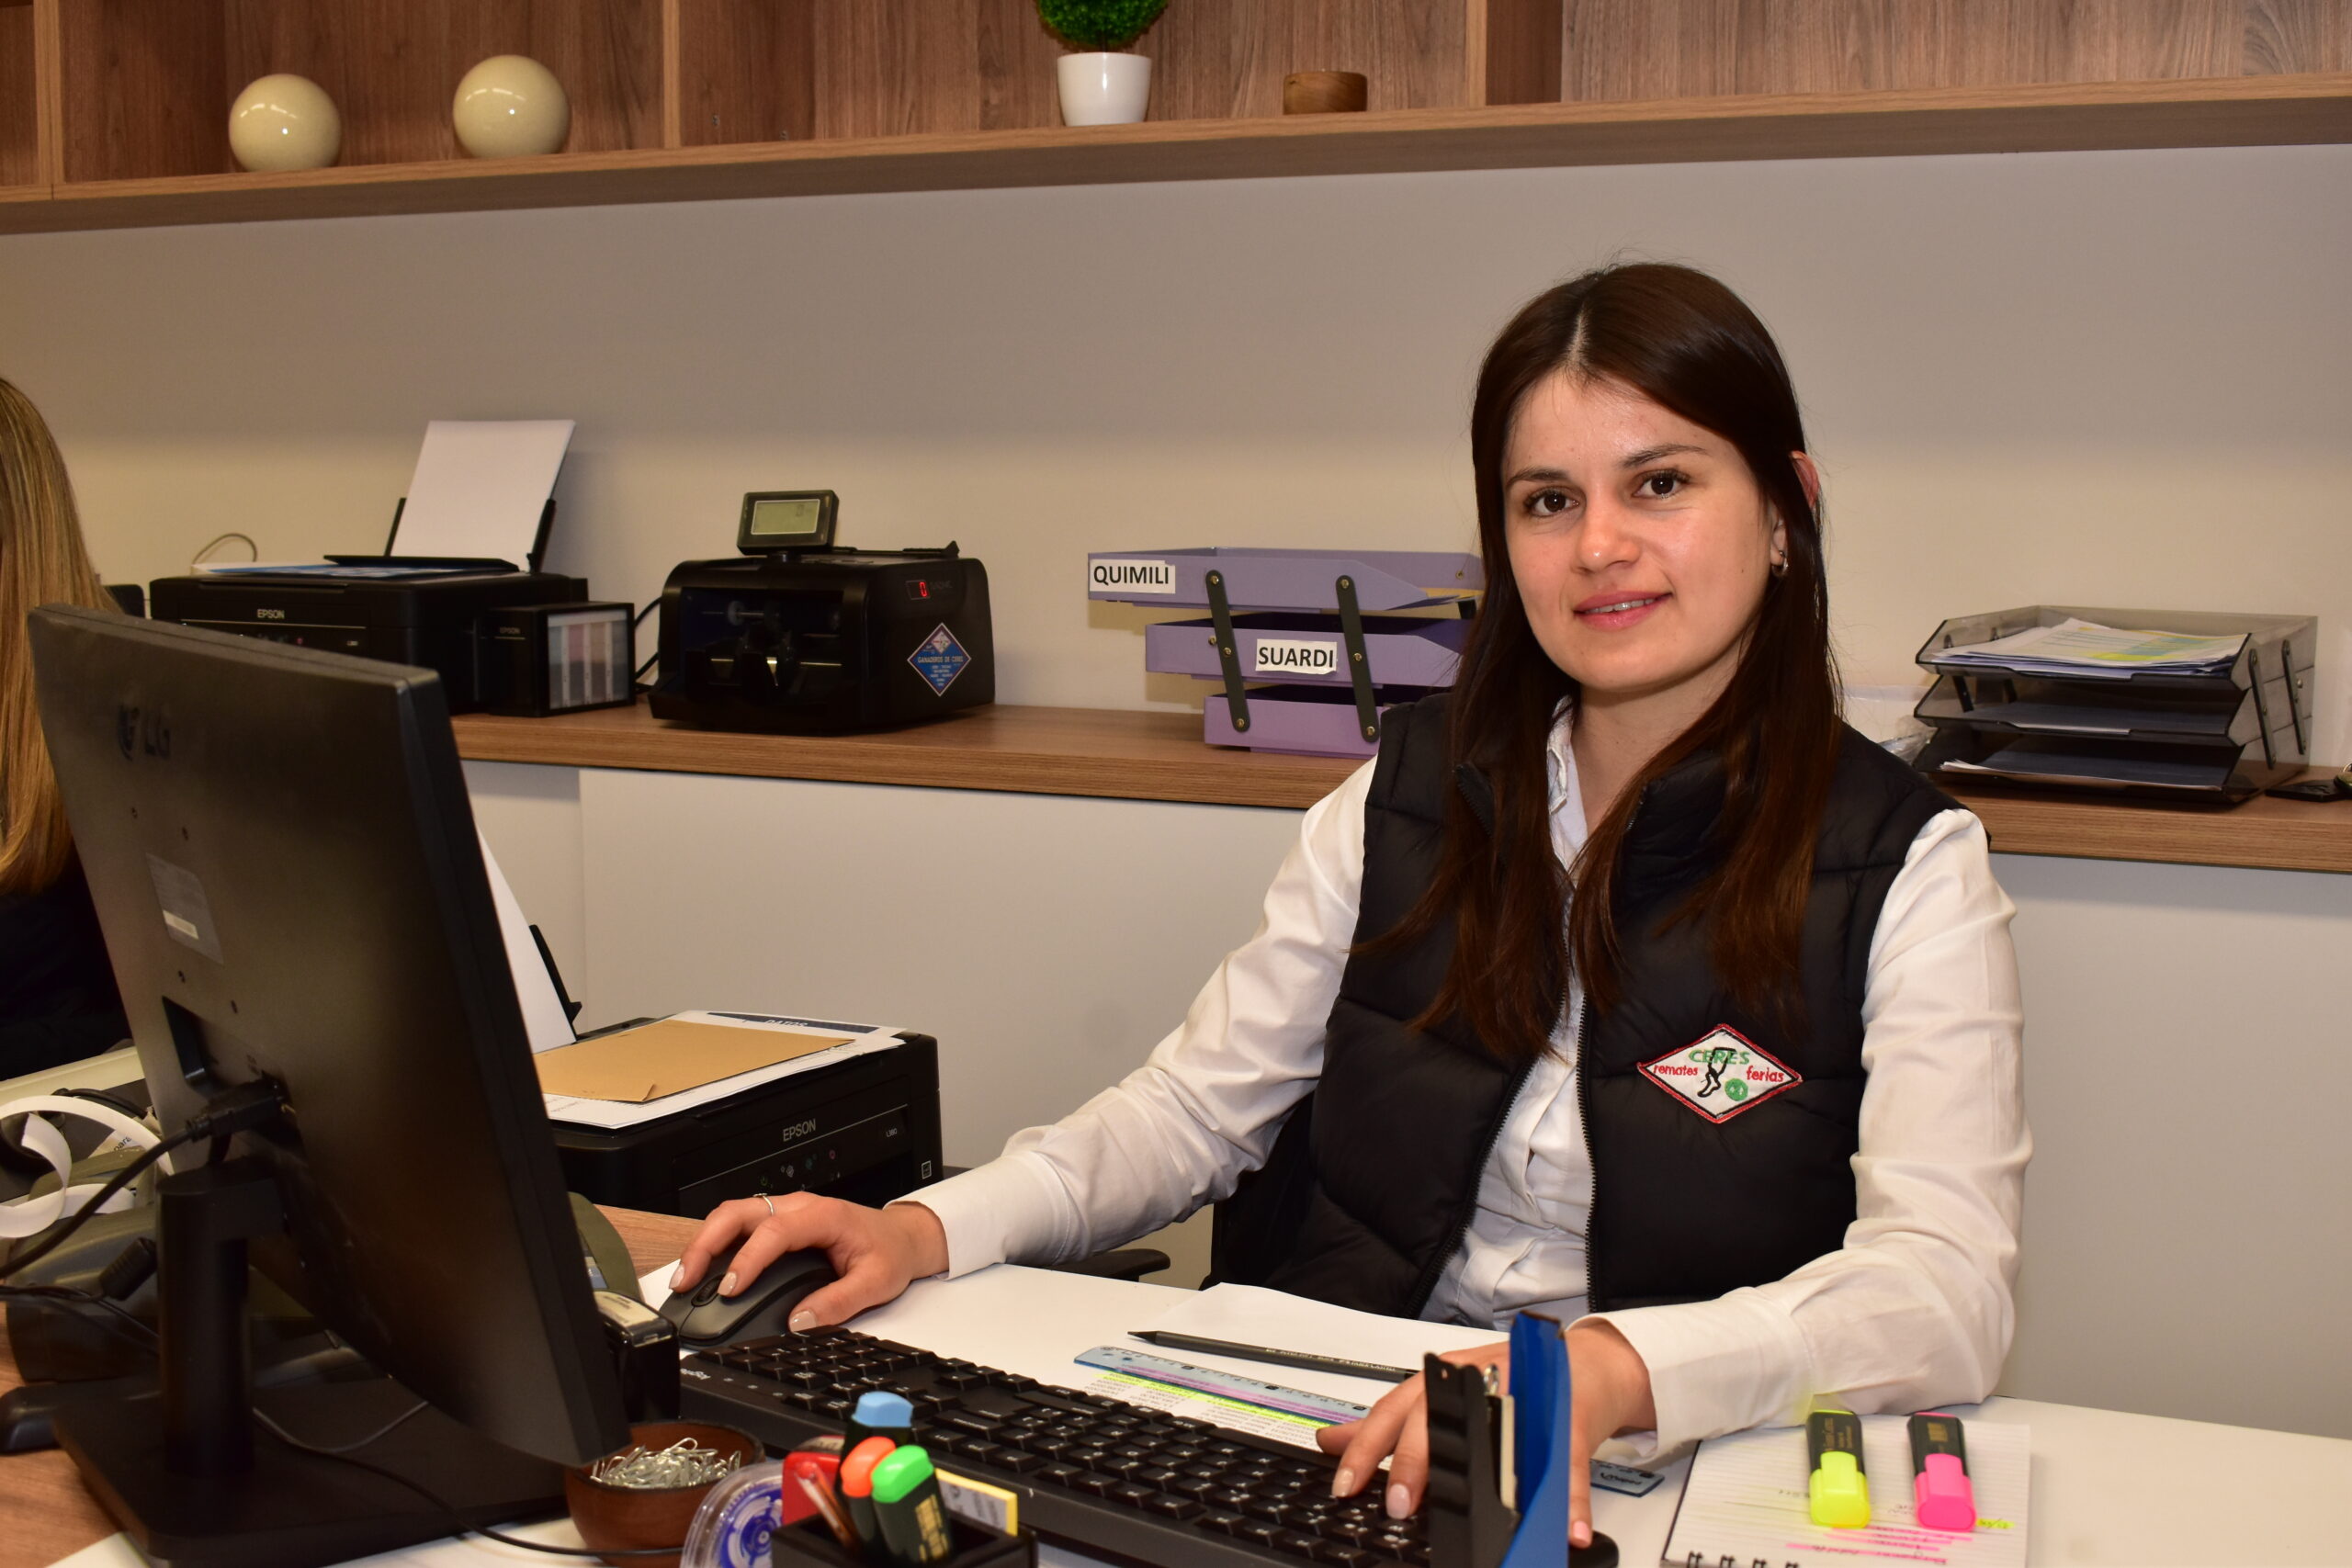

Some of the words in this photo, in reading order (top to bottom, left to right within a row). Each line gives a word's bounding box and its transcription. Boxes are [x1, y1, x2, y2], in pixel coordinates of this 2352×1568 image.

[1092, 564, 1170, 586] QUIMILI
[257, 608, 285, 619] EPSON
[1258, 646, 1334, 669] SUARDI
[1688, 1049, 1750, 1066] CERES
[1653, 1064, 1699, 1077] remates
[1746, 1066, 1785, 1083] ferias
[783, 1118, 817, 1142] EPSON
